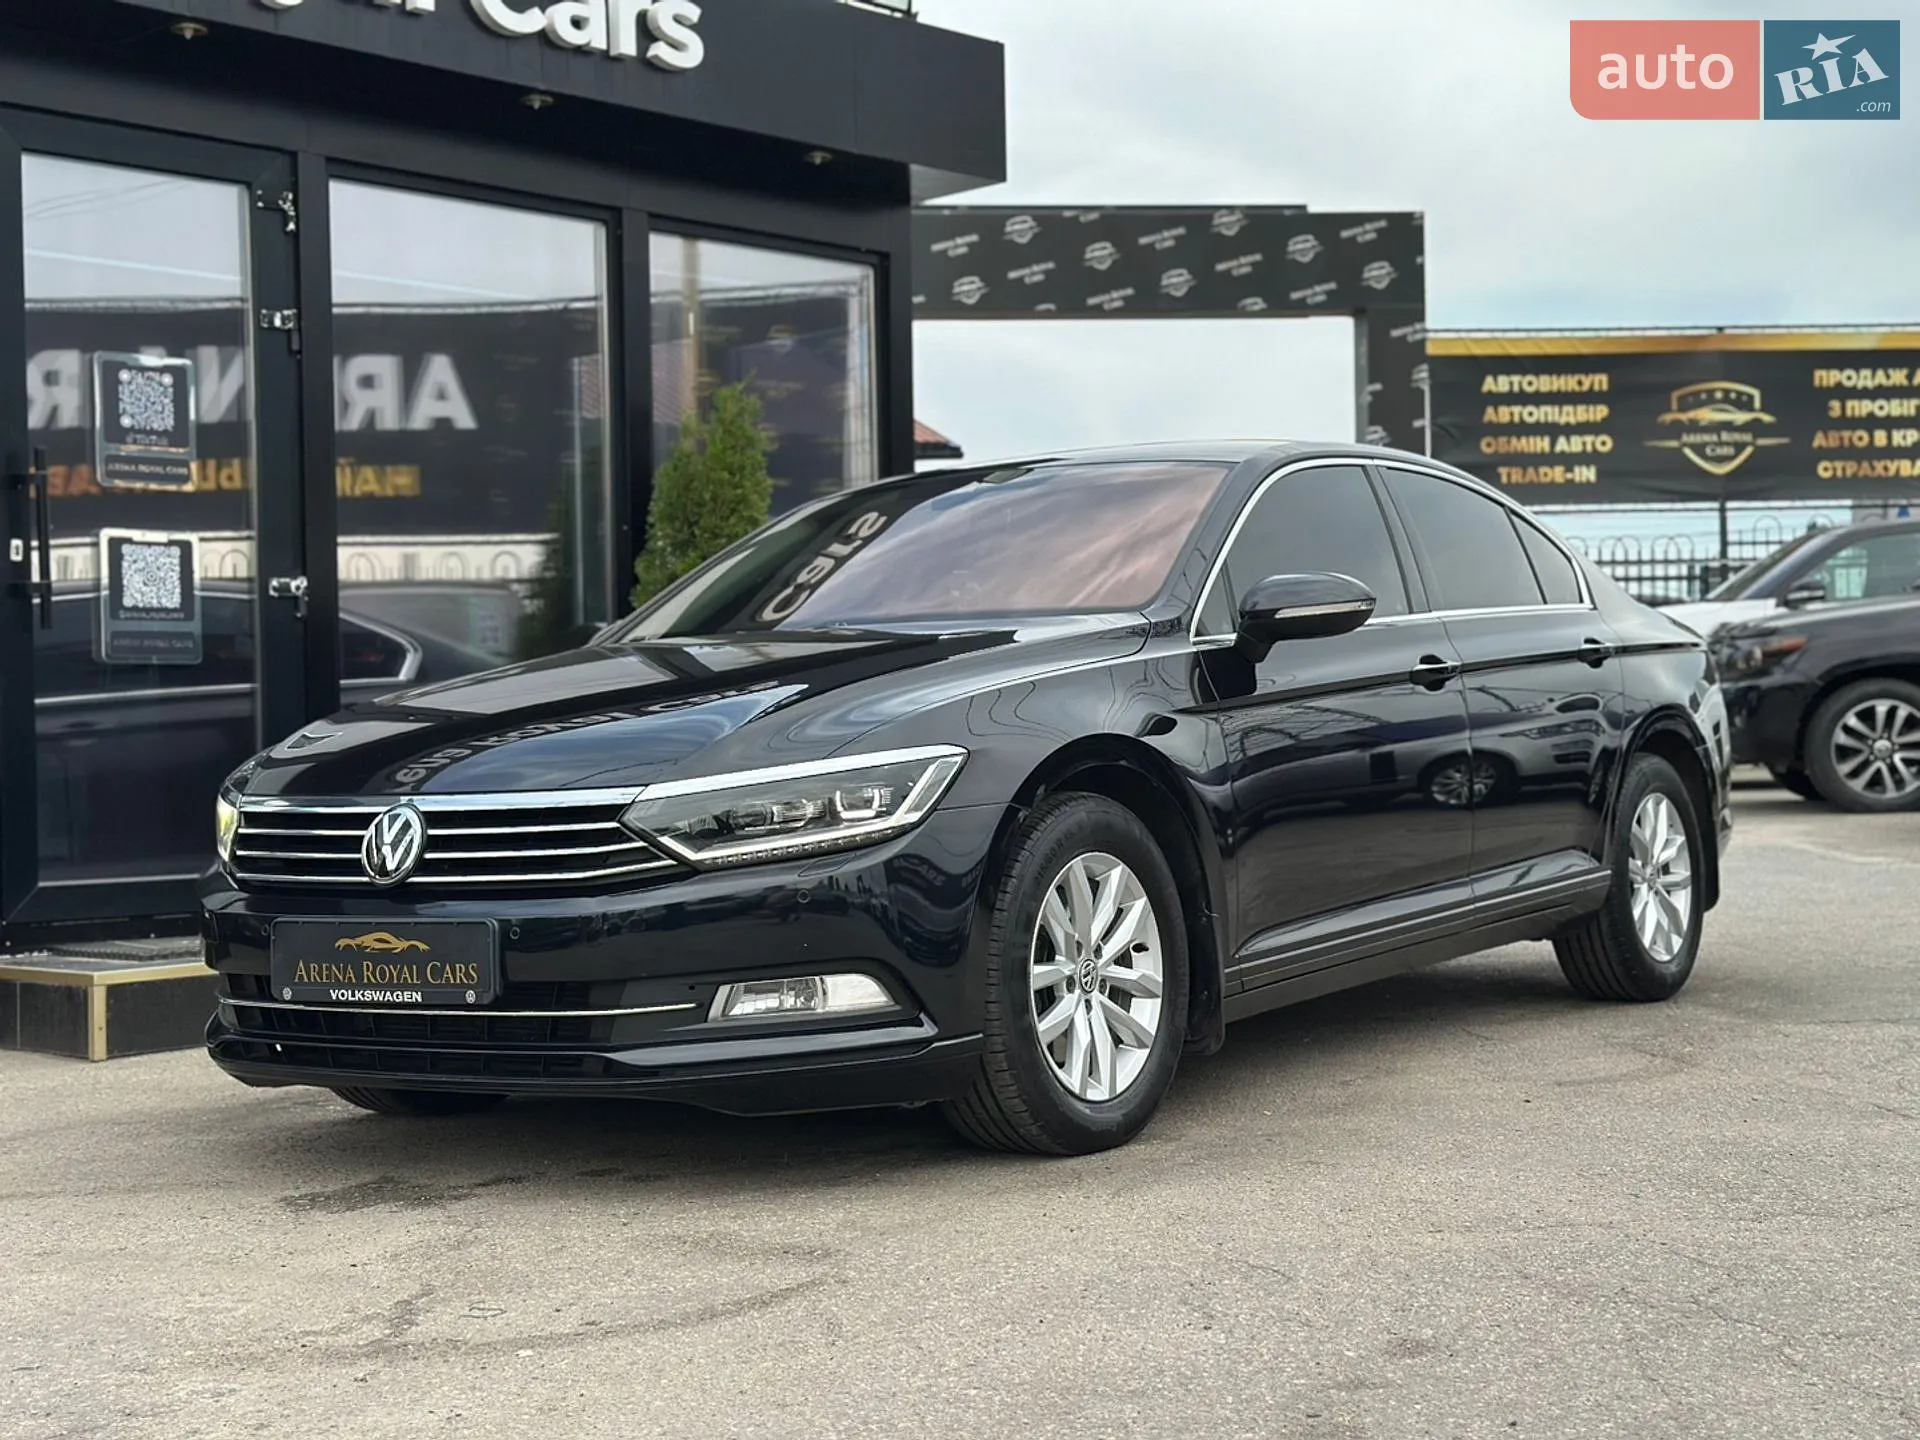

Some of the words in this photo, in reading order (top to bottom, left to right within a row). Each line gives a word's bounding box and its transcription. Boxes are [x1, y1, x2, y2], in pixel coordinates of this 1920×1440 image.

[1481, 373, 1609, 393] АВТОВИКУП
[1813, 367, 1910, 390] ПРОДАЖ
[1482, 403, 1610, 426] АВТОПІДБІР
[1480, 436, 1551, 454] ОБМІН
[1553, 434, 1614, 453] АВТО
[1811, 429, 1870, 449] АВТО
[1497, 464, 1597, 484] TRADE-IN
[329, 989, 423, 1003] VOLKSWAGEN
